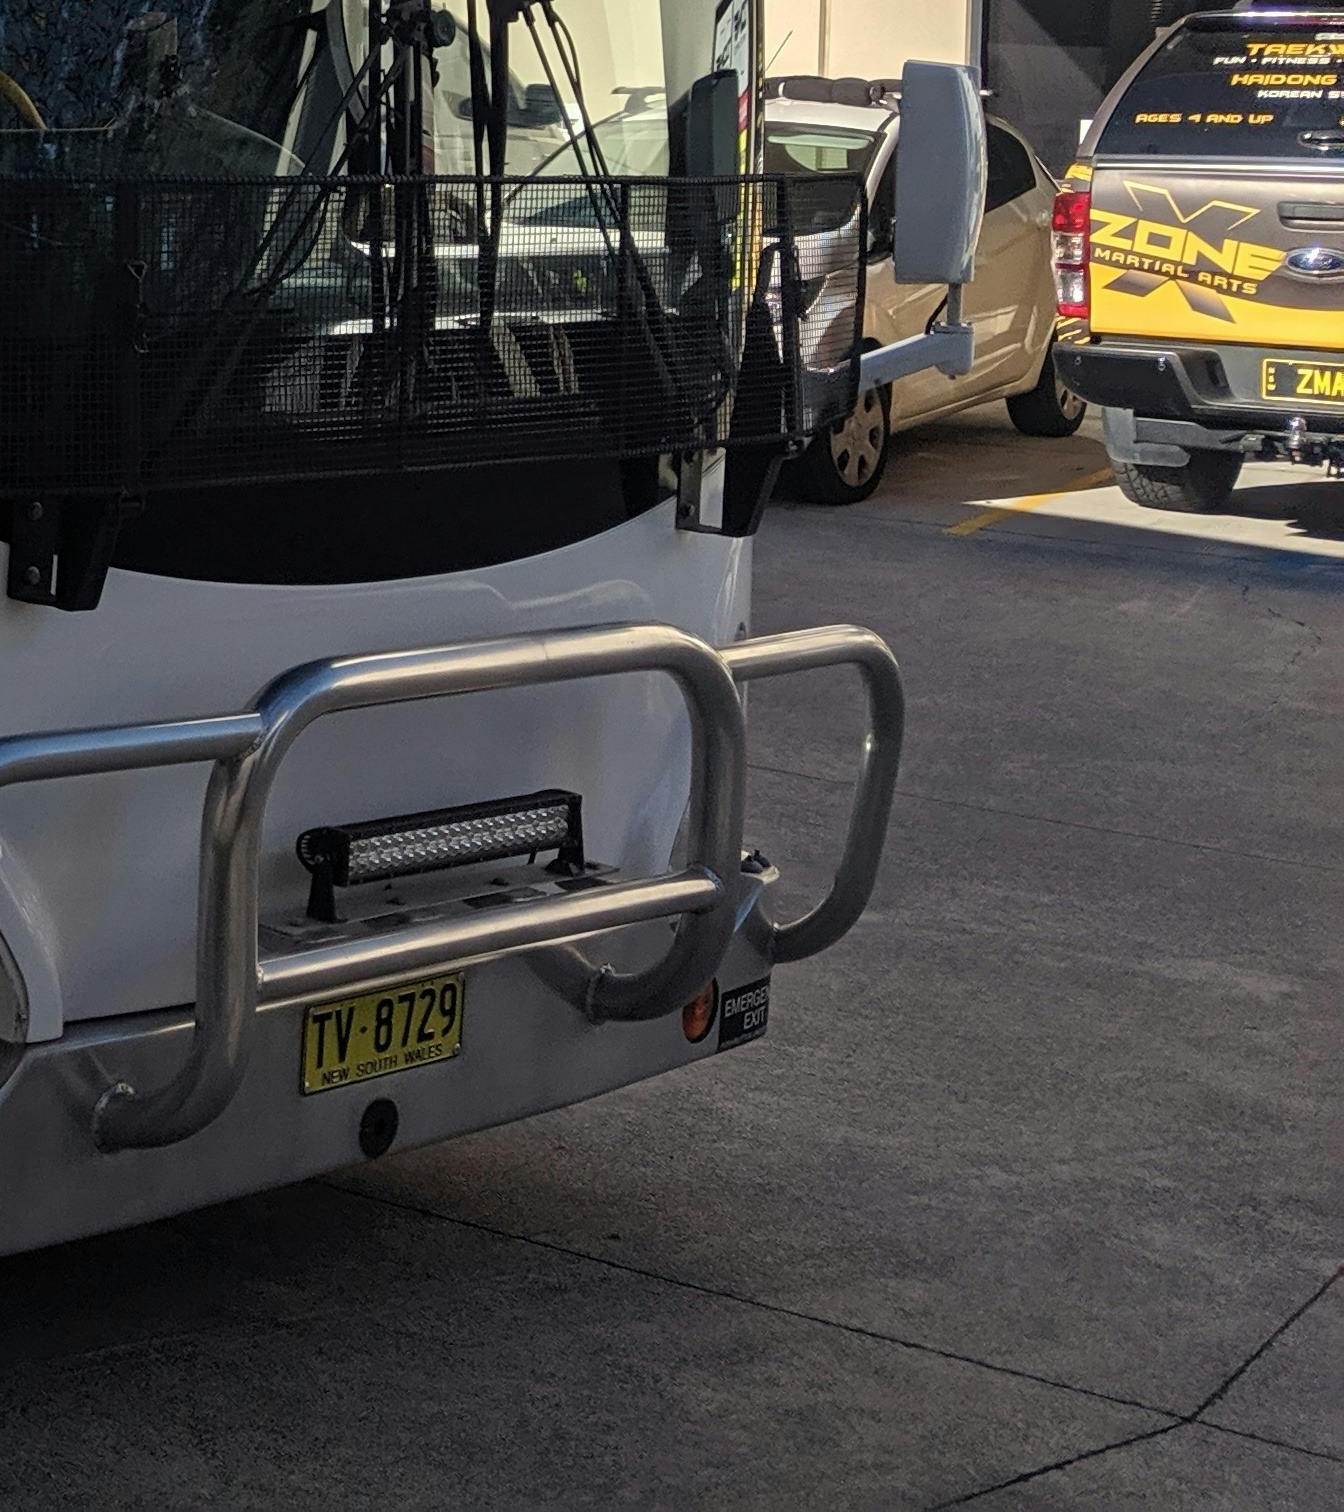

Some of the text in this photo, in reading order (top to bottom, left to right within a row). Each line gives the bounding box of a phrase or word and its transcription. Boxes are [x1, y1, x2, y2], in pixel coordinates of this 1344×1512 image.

[1213, 56, 1331, 65] FUN FITNESS
[1231, 74, 1338, 86] HAIDONG
[1257, 90, 1324, 99] KOREAN
[1135, 113, 1274, 124] AGES 4 AND UP
[1090, 208, 1288, 281] ZONE
[1094, 247, 1258, 294] MARTIAL ARTS
[724, 986, 770, 1018] EMERGE
[743, 1005, 765, 1030] EXIT
[321, 1043, 443, 1086] NEW SOUTH WALES
